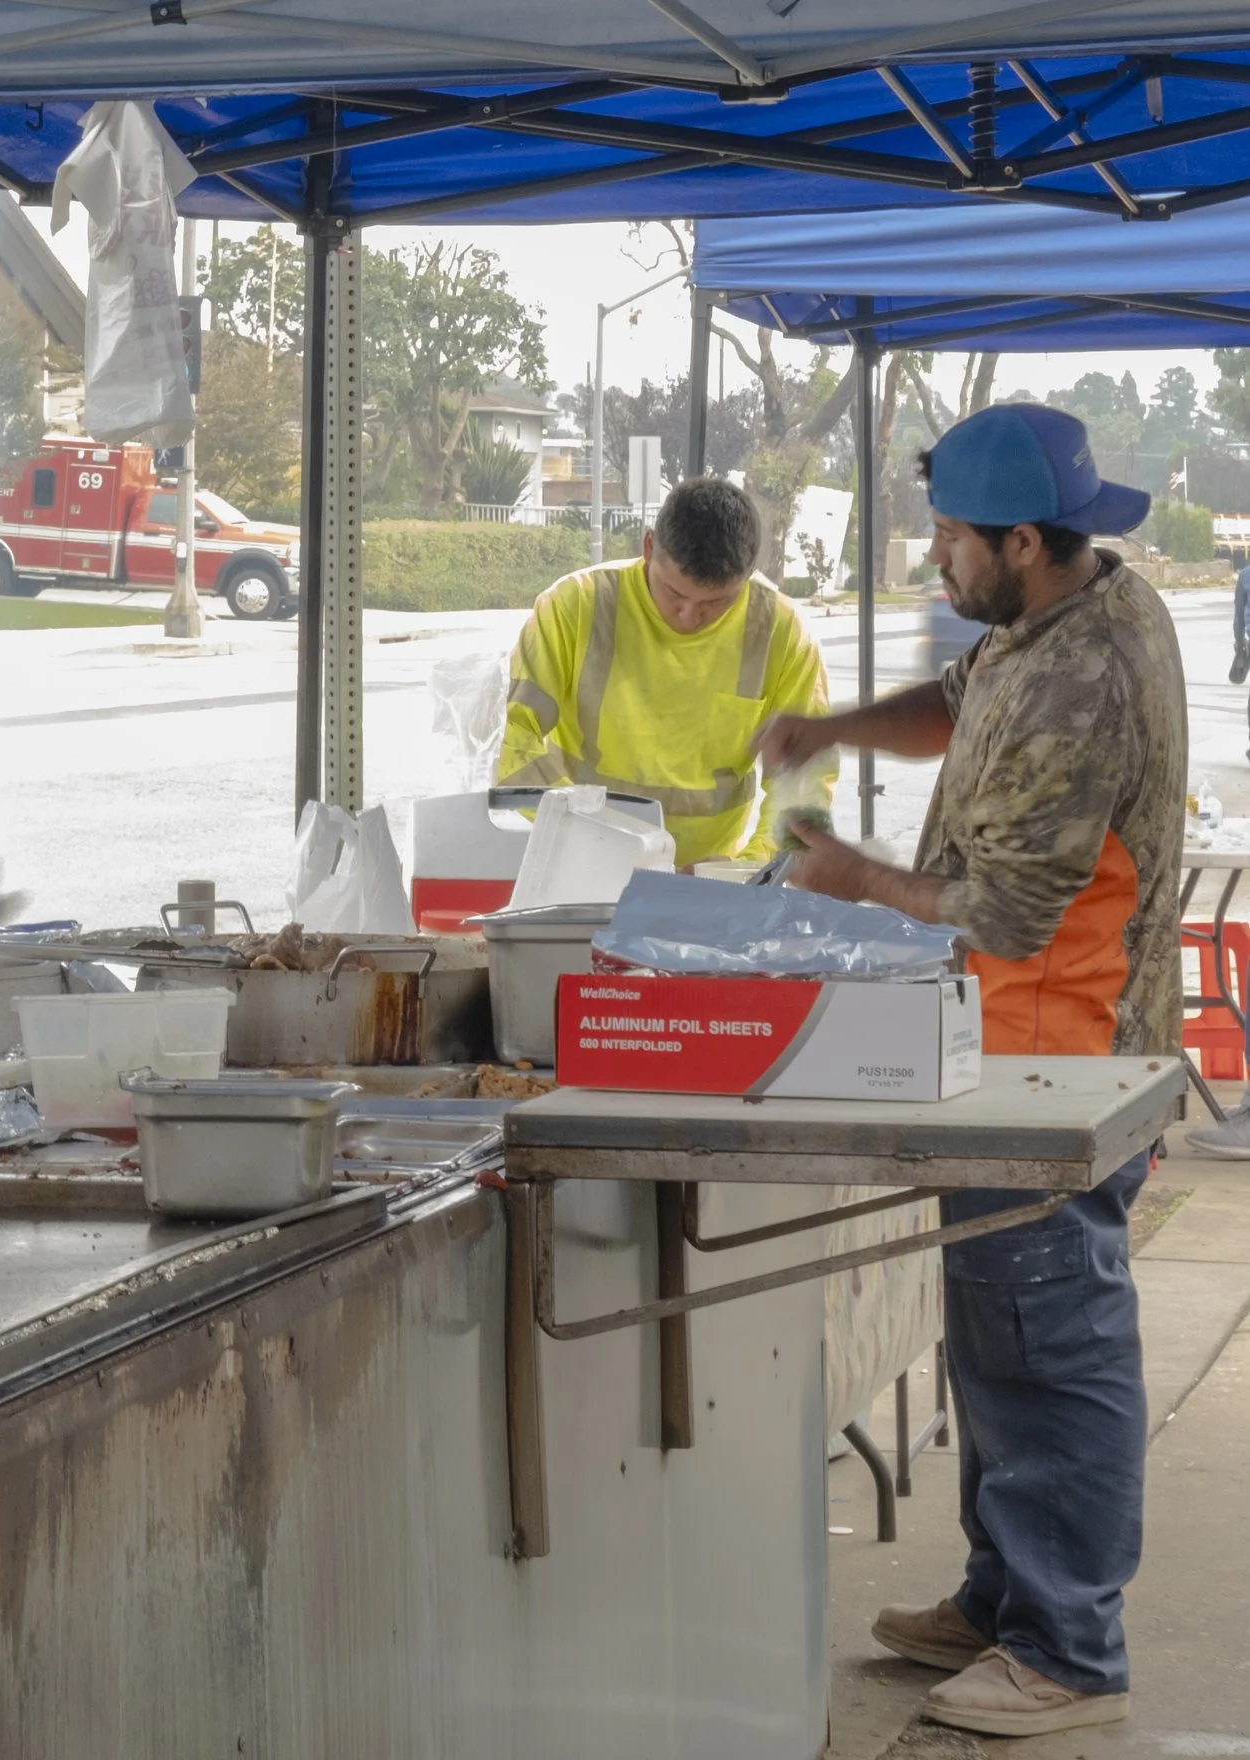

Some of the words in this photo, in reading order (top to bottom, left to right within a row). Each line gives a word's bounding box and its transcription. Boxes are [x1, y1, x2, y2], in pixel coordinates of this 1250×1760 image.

[78, 471, 103, 489] 69
[579, 987, 641, 1000] WellChoice
[579, 1015, 665, 1033] ALUMINUM
[668, 1019, 705, 1034] FOIL
[708, 1020, 773, 1037] SHEETS
[579, 1038, 599, 1049] 500
[601, 1038, 682, 1052] INTERFOLDED
[857, 1066, 915, 1078] PUS12500
